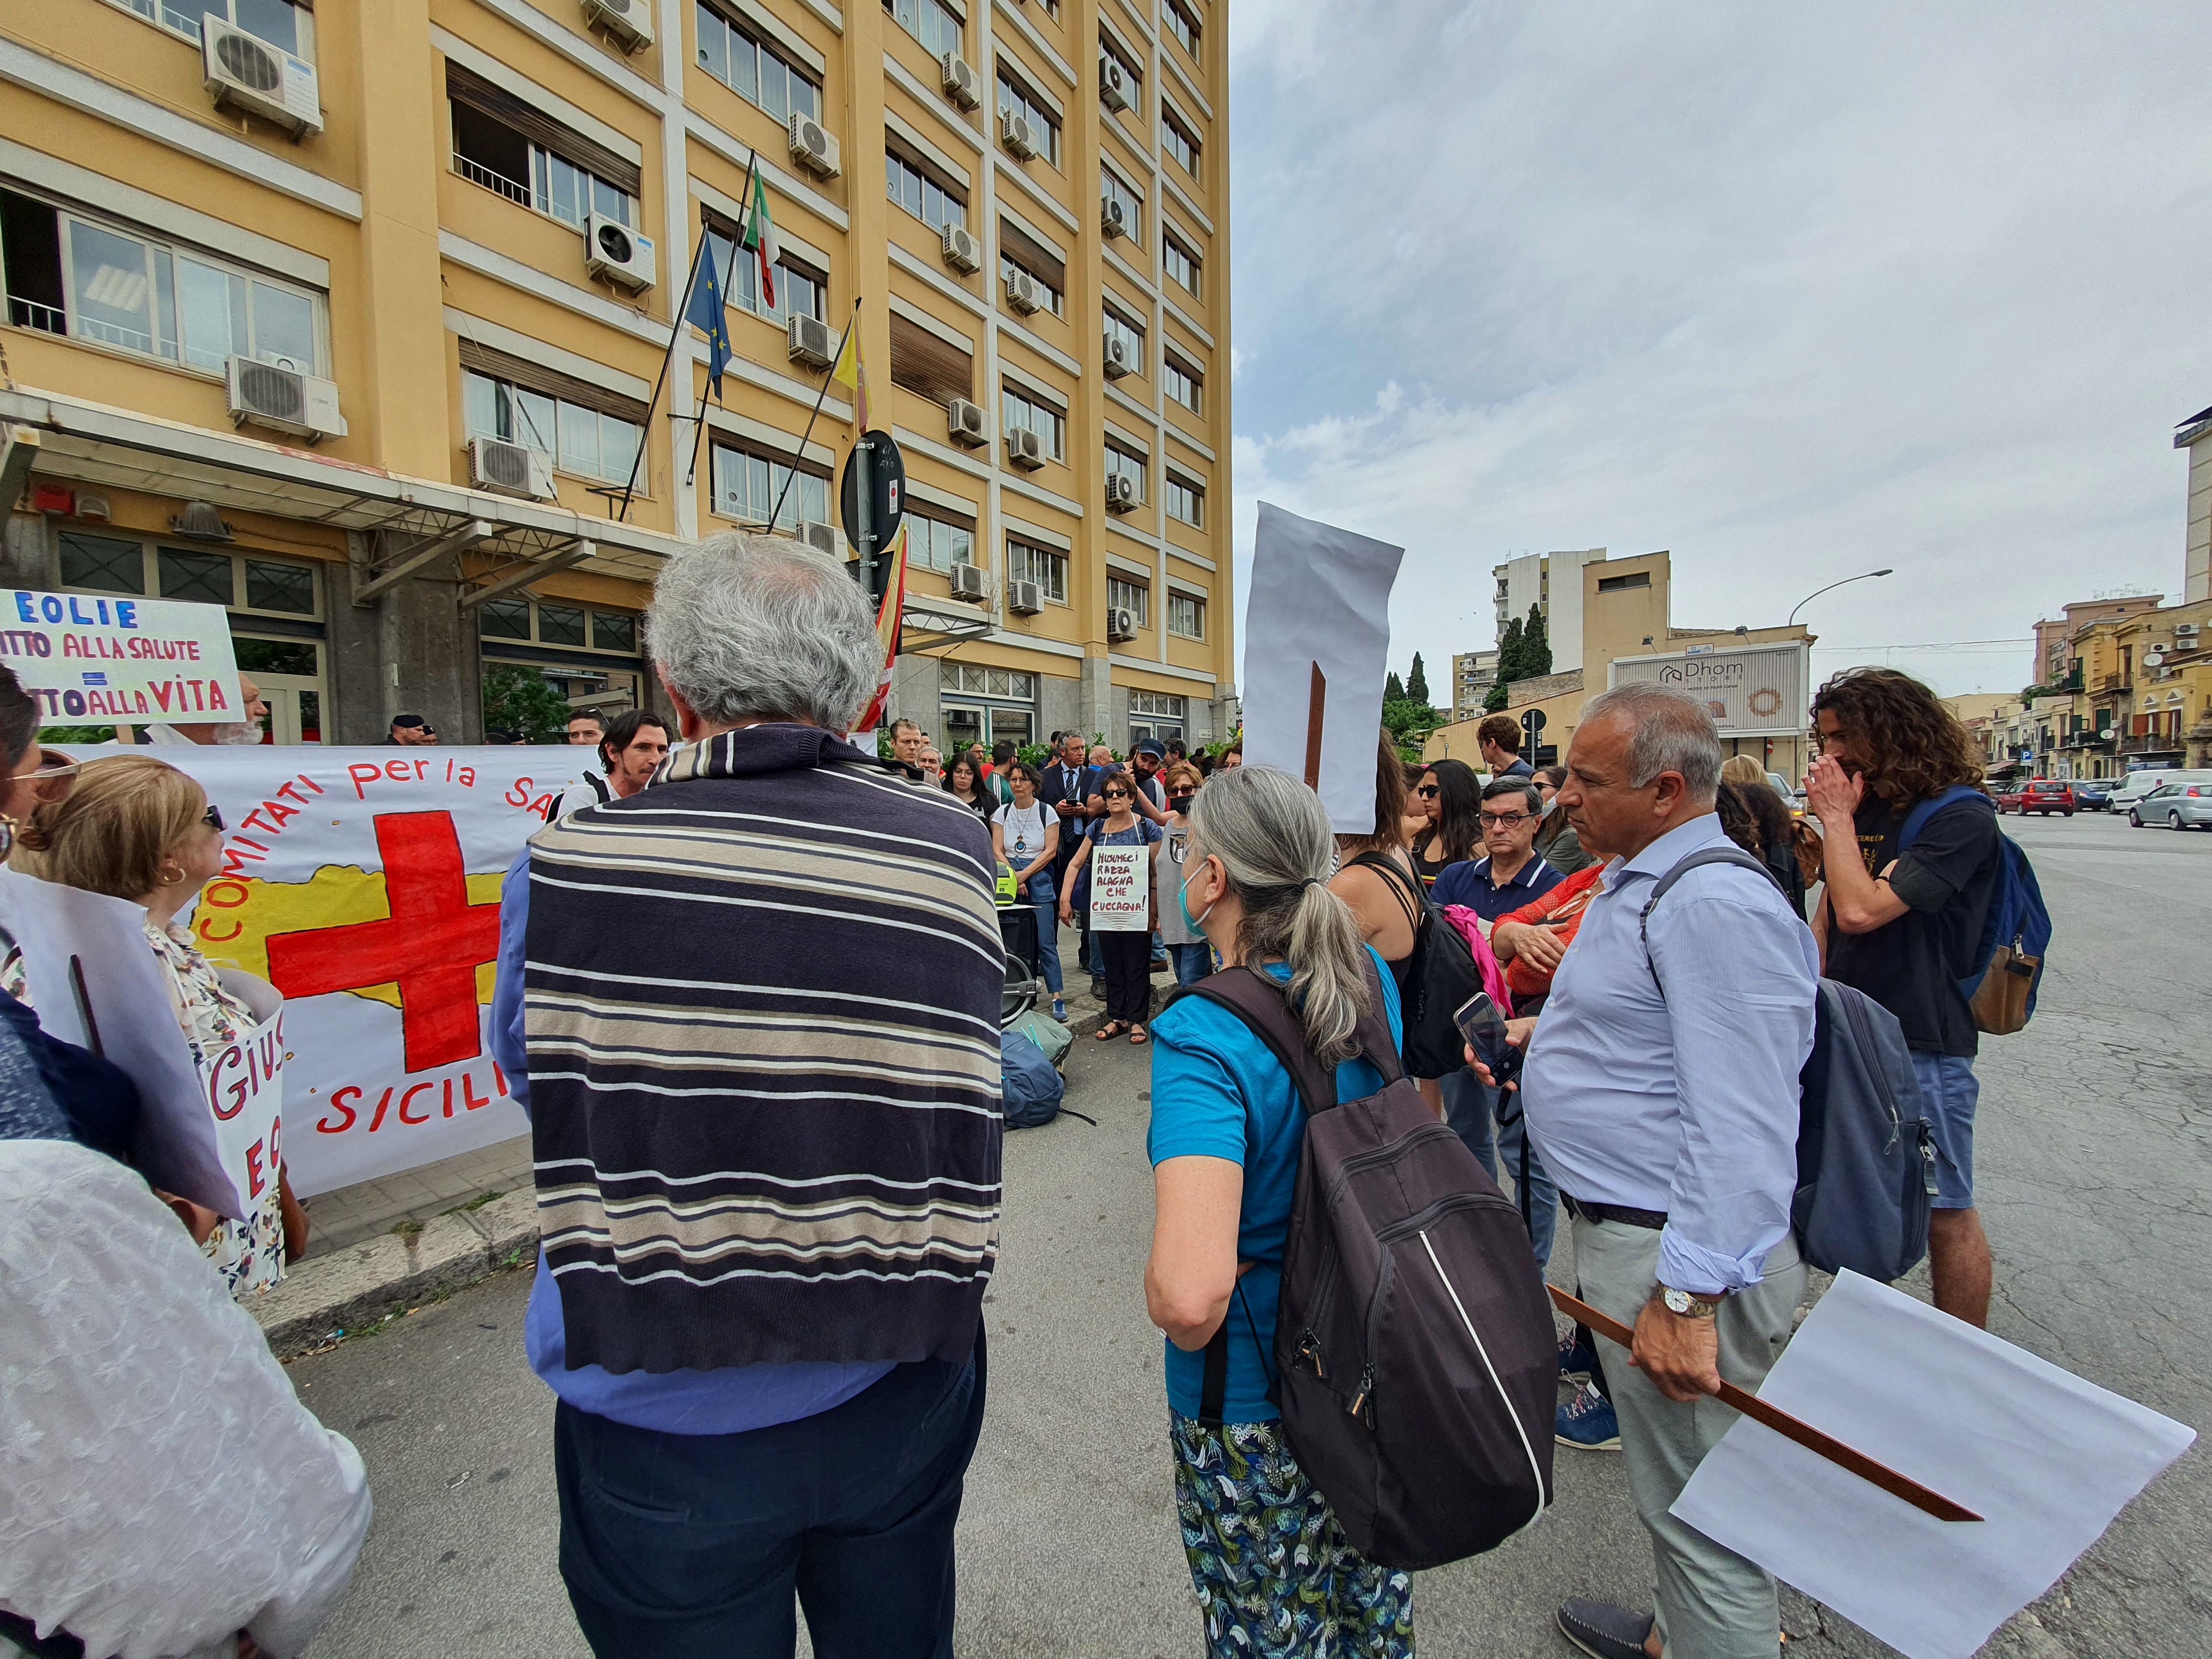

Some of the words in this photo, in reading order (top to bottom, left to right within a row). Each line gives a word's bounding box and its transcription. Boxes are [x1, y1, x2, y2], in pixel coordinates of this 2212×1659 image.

[14, 591, 138, 628] EOLIE
[63, 633, 125, 659] ALLA
[127, 637, 200, 661] SALUTE
[1685, 661, 1743, 677] Dhom
[1685, 674, 1743, 684] STORE
[88, 689, 150, 715] ALLA
[199, 774, 325, 942] COMITATI
[1097, 865, 1130, 875] RAZZA
[1096, 876, 1133, 887] ALAGNA
[1106, 887, 1127, 897] CHE
